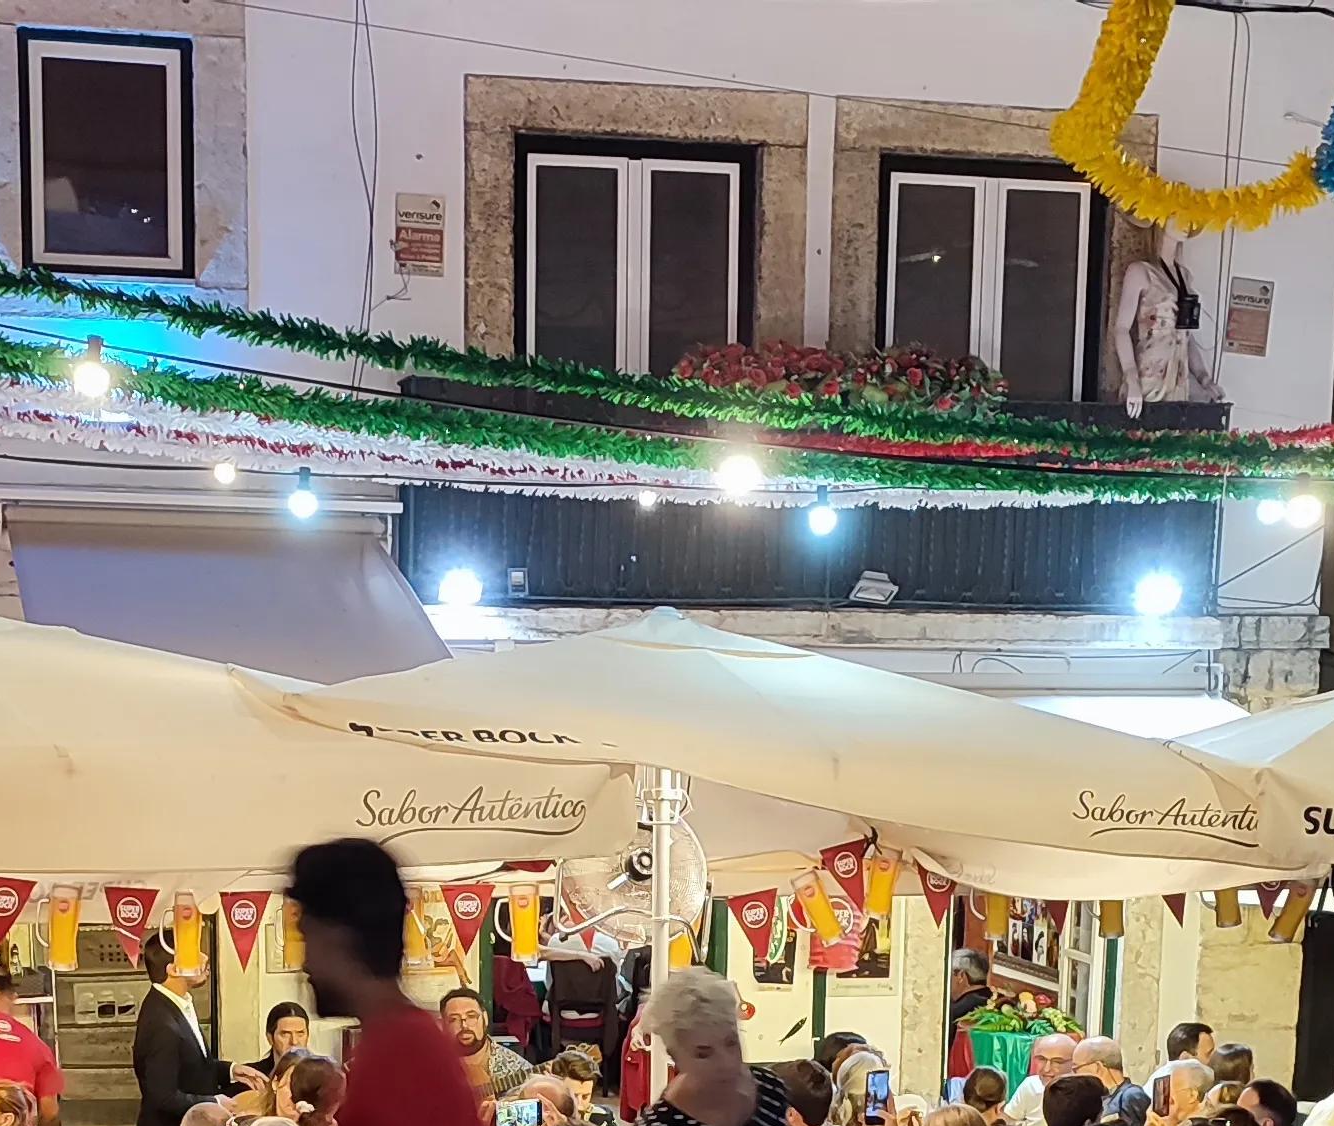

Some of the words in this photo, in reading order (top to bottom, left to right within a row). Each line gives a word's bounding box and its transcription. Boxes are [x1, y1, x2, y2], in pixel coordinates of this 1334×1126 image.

[398, 210, 442, 221] verisure
[1232, 293, 1271, 305] verisure
[355, 789, 448, 827] Sabor
[448, 786, 586, 824] Autêntico
[1072, 790, 1153, 825] Sabor
[1154, 798, 1259, 831] Autênti
